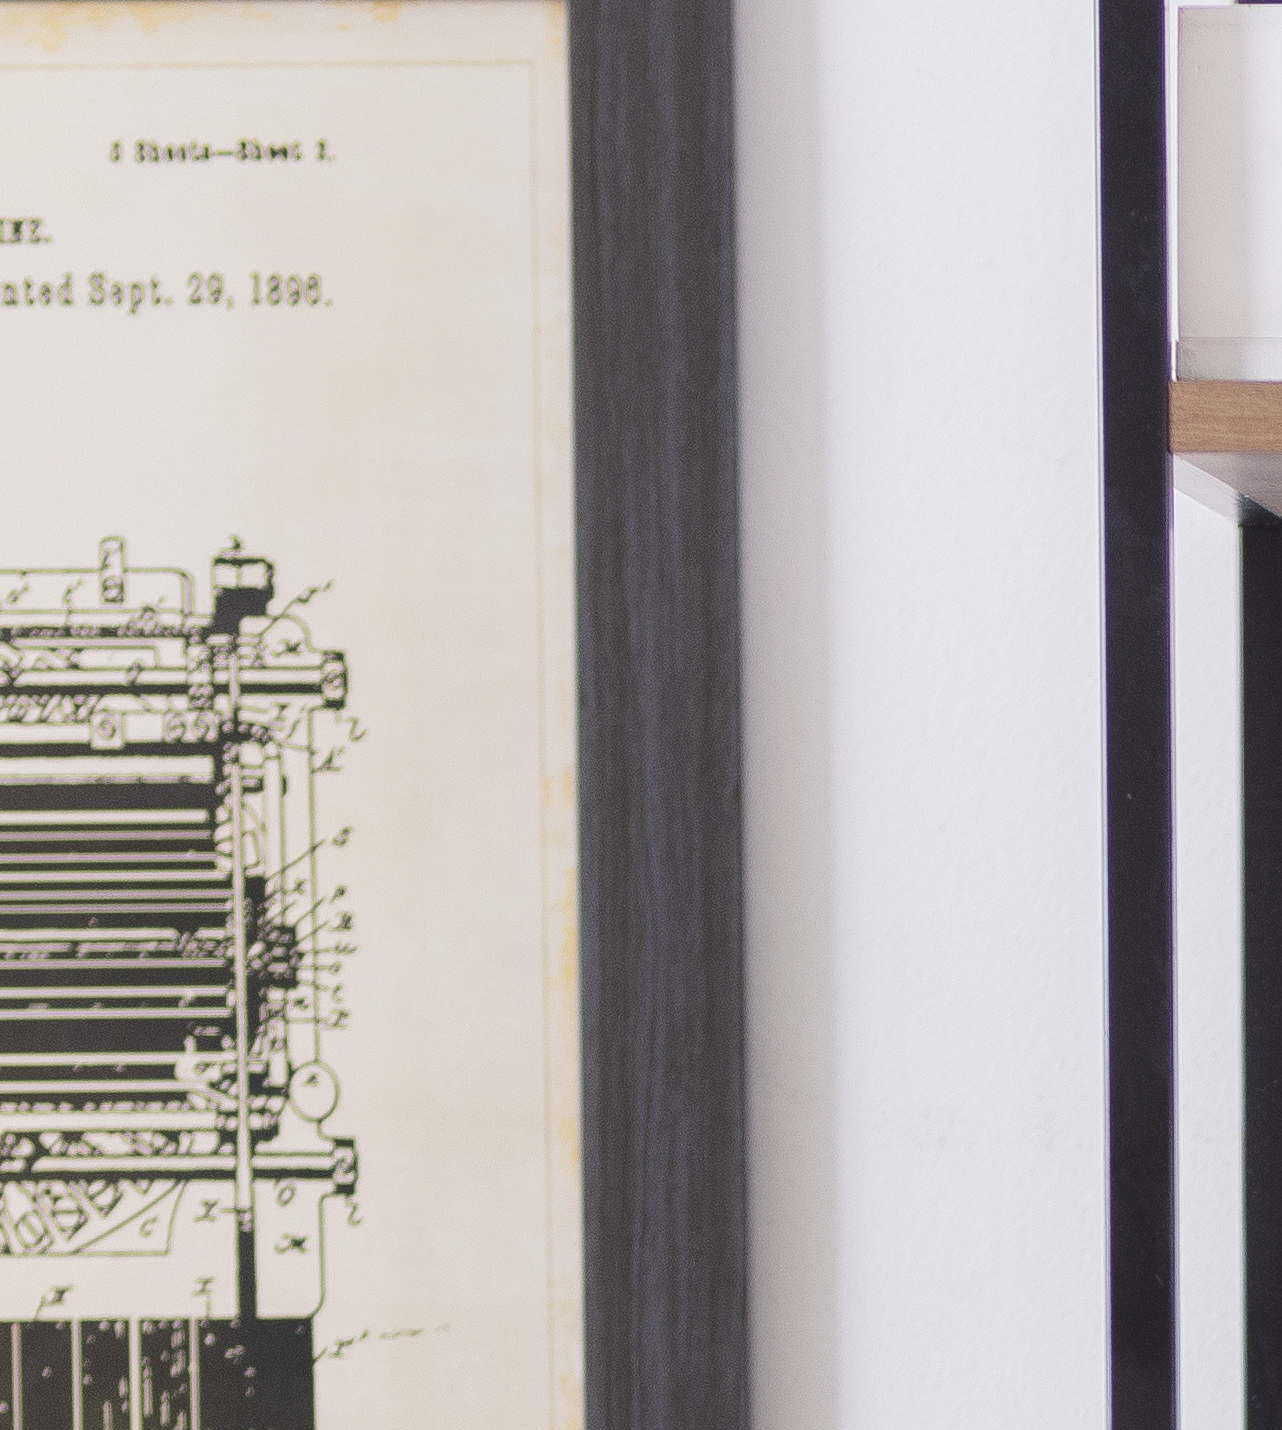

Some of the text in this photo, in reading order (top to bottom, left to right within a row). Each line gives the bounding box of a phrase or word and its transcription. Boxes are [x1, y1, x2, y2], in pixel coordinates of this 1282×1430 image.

[88, 271, 172, 315] Sept.
[187, 271, 234, 308] 29,
[249, 271, 333, 306] 1896.
